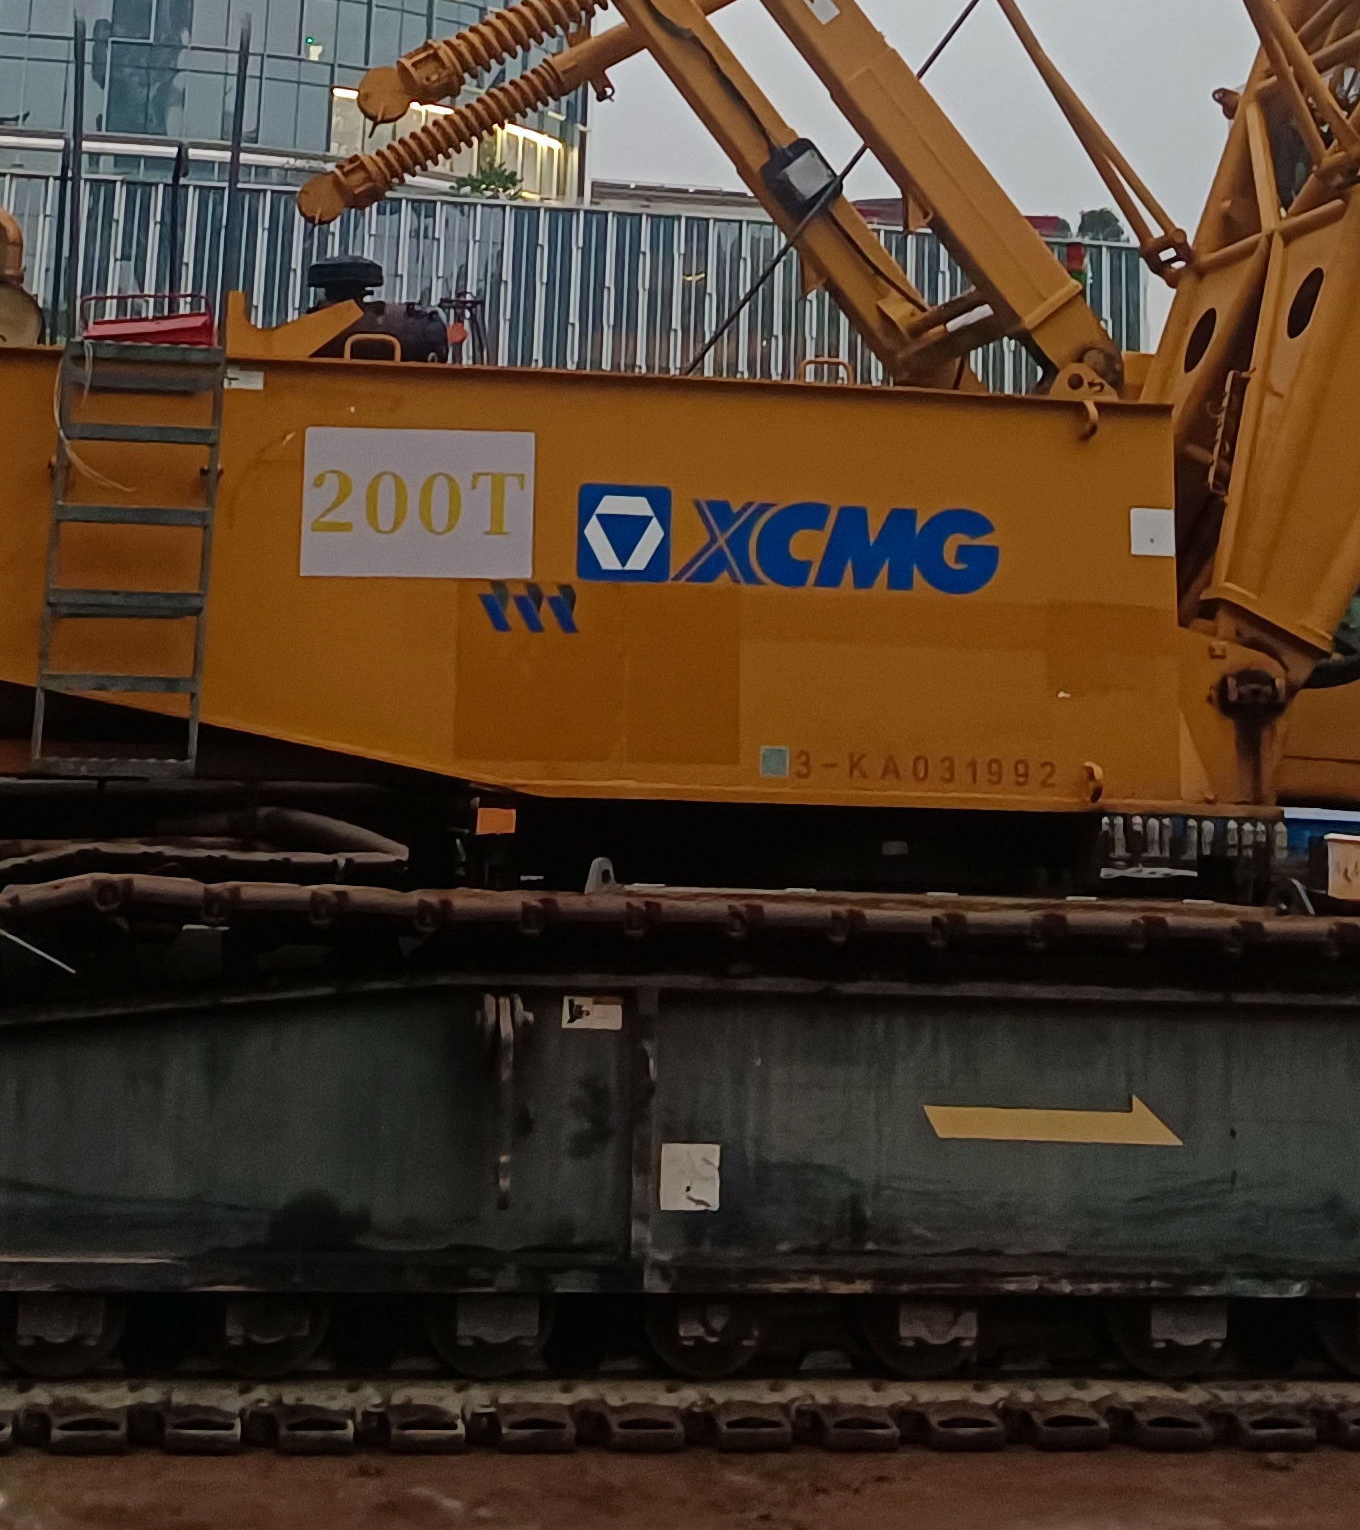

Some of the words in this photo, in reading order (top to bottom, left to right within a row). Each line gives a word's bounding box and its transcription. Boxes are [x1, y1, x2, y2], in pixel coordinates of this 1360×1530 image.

[310, 469, 526, 538] 200T
[670, 498, 1001, 595] XCMG
[794, 749, 1058, 789] 3-KA031992
